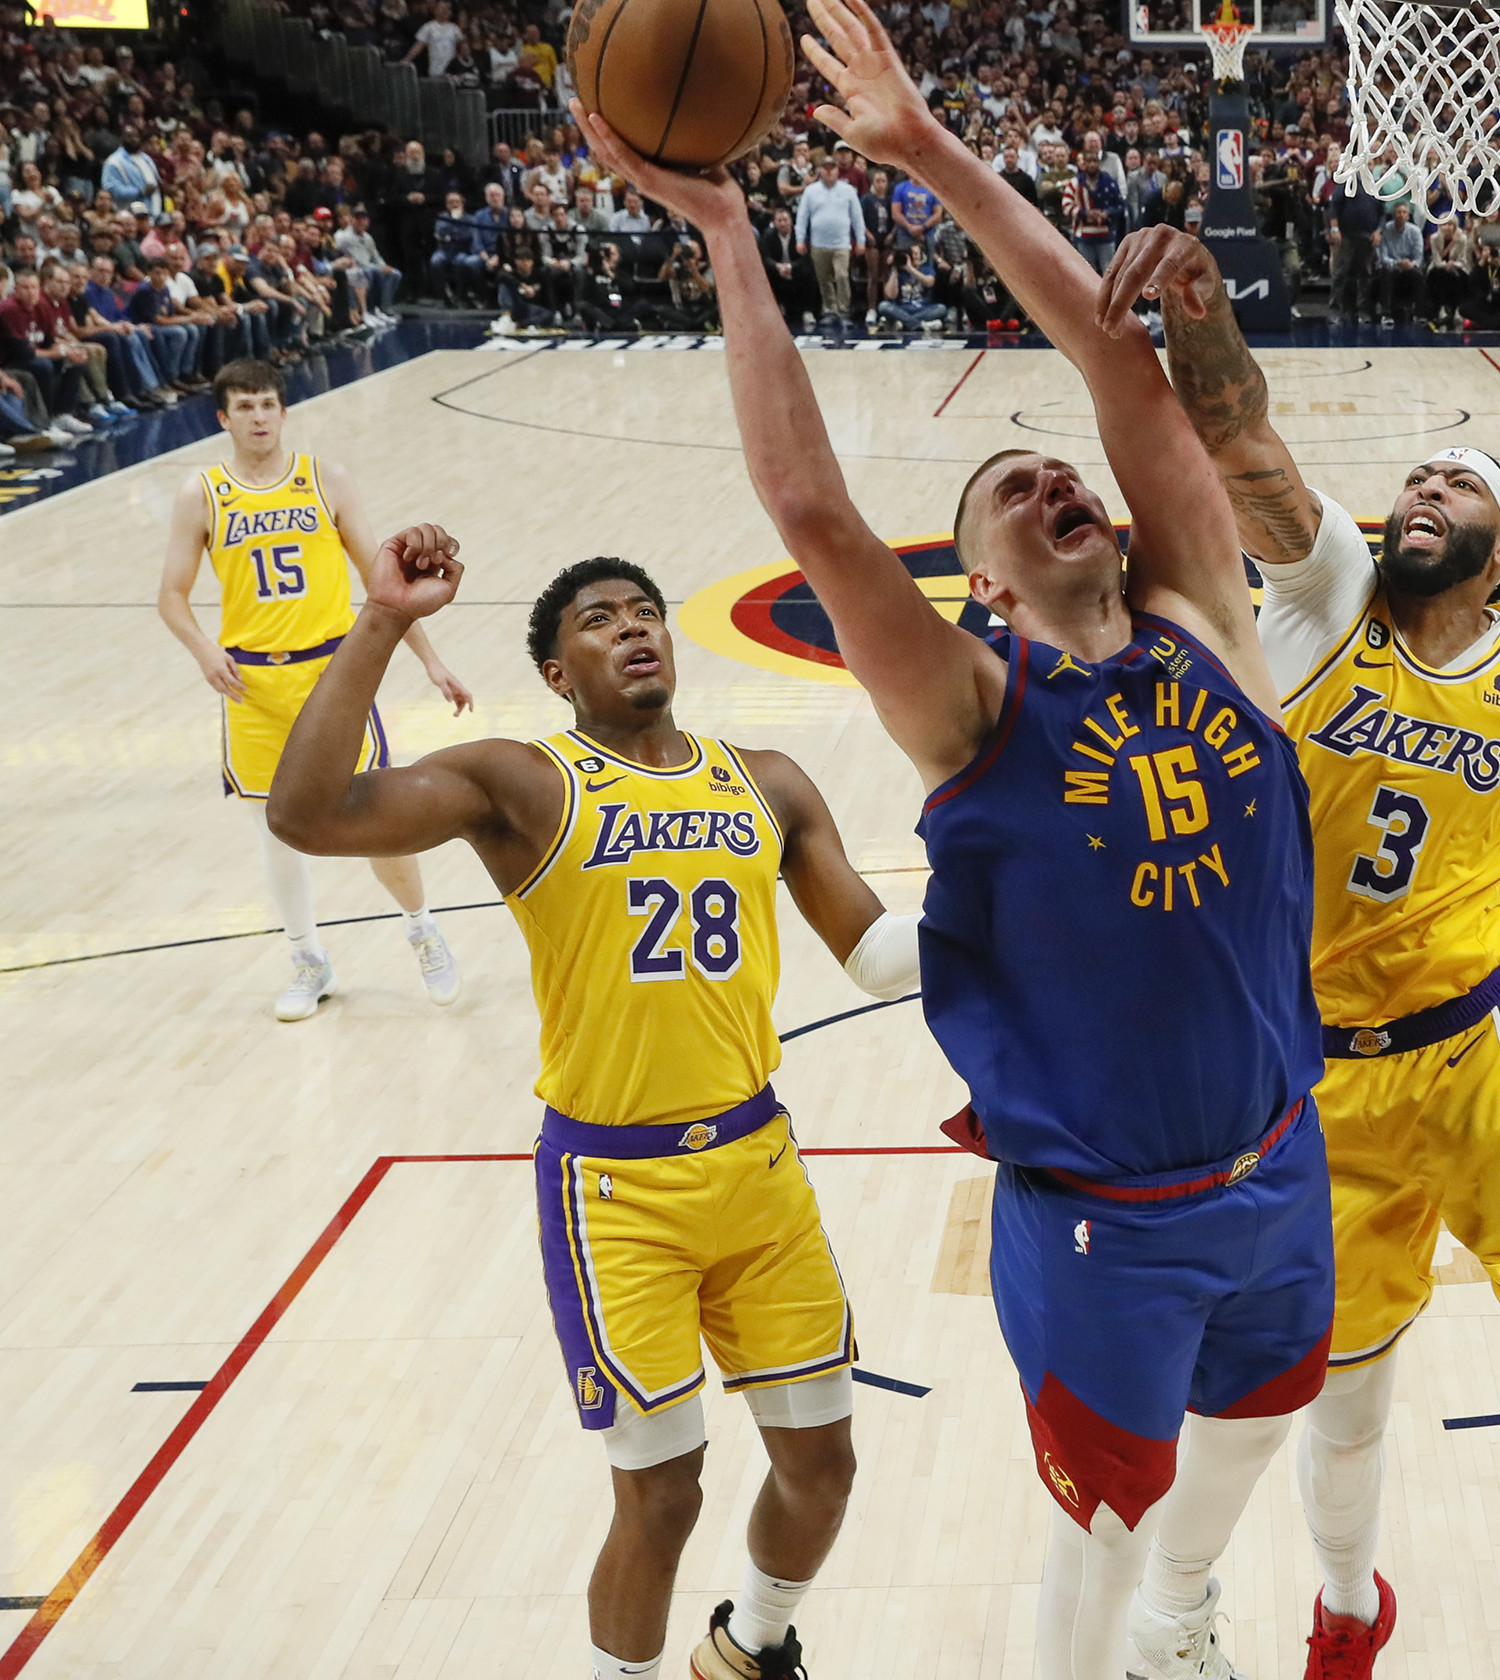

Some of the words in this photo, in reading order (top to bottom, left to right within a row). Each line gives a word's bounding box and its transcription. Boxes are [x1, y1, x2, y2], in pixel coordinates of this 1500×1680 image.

[1204, 226, 1235, 239] Google
[1236, 226, 1257, 237] Pixel
[222, 506, 319, 548] LAKERS
[250, 544, 308, 603] 15
[1168, 648, 1189, 672] stern
[1369, 621, 1384, 647] 6
[580, 760, 601, 773] 6
[1064, 692, 1141, 805] MILE
[1155, 681, 1261, 779] HIGH
[708, 781, 746, 796] bibigo
[1128, 744, 1210, 842] 15
[580, 802, 761, 872] LAKERS
[1346, 784, 1432, 904] 3
[1129, 843, 1231, 911] CITY
[625, 876, 743, 983] 28
